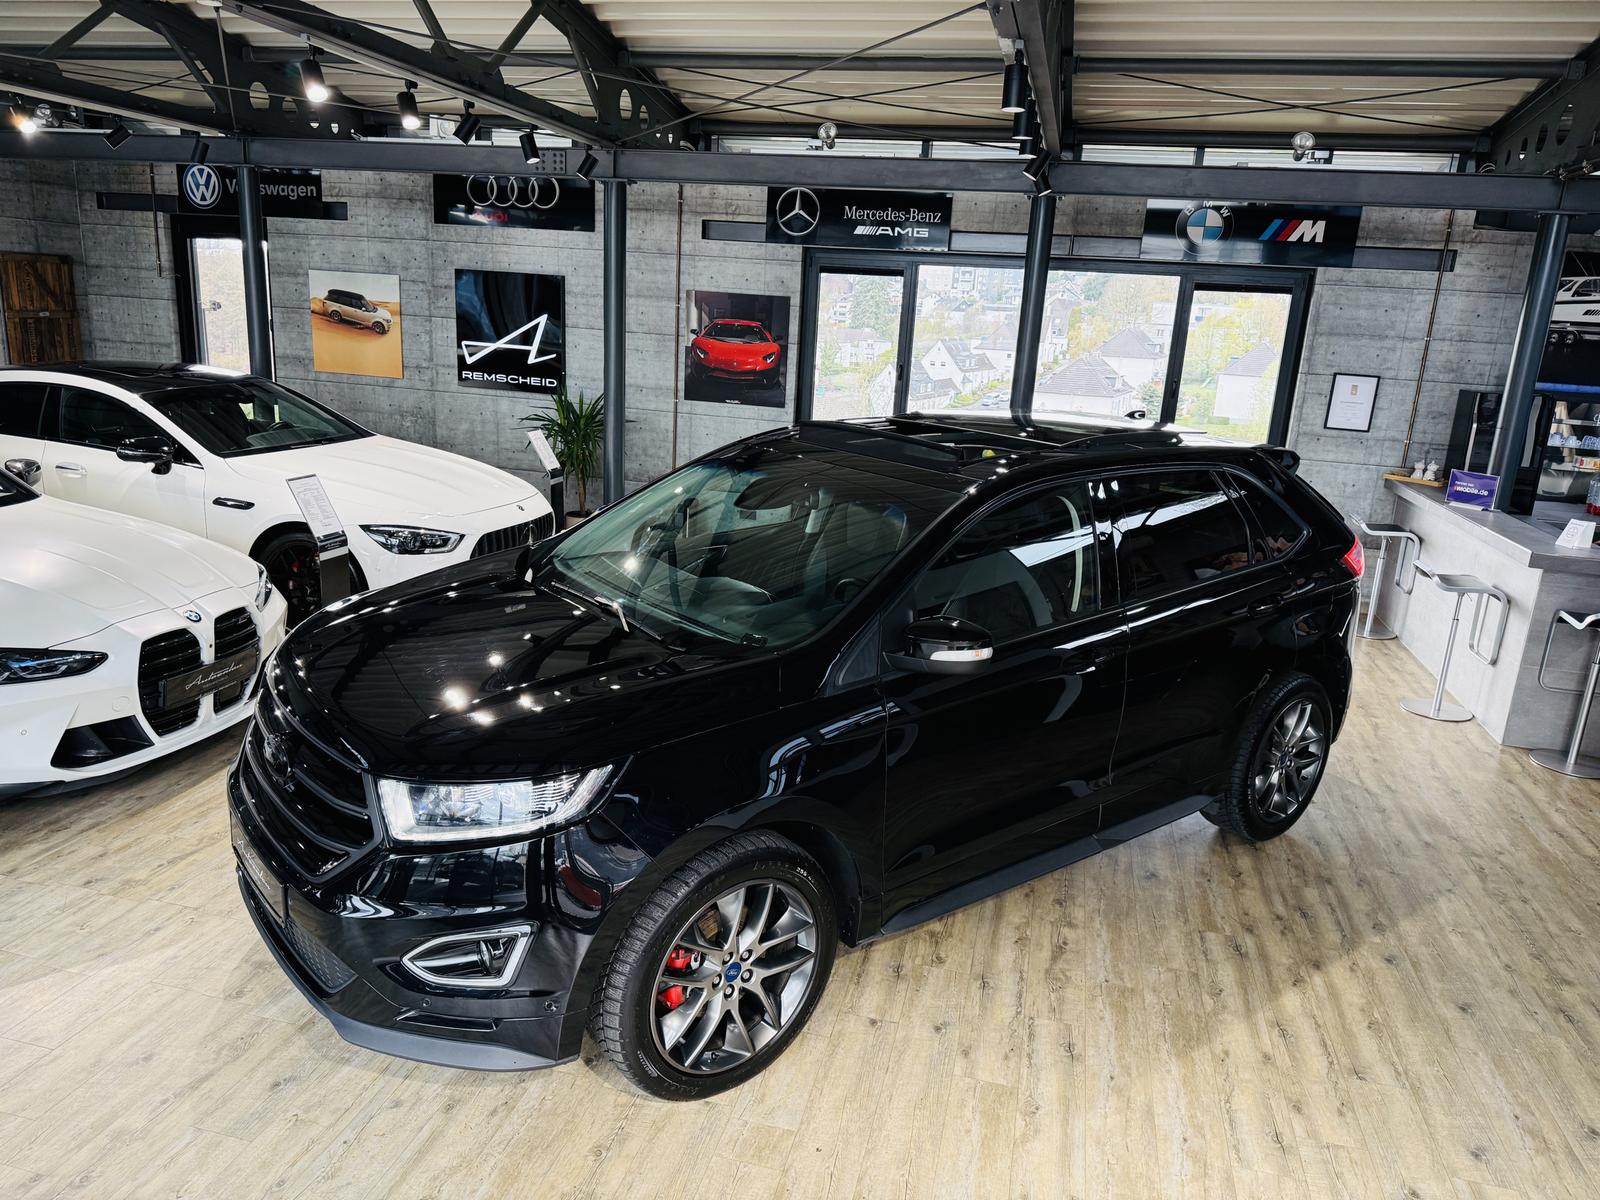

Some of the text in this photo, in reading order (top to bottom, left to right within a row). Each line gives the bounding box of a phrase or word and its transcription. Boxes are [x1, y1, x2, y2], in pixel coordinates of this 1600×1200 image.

[225, 178, 317, 200] Vswagen
[843, 205, 942, 223] Mercedes-Benz
[1184, 200, 1230, 218] BMW
[876, 226, 929, 238] AMG
[462, 371, 558, 387] REMSCHEID
